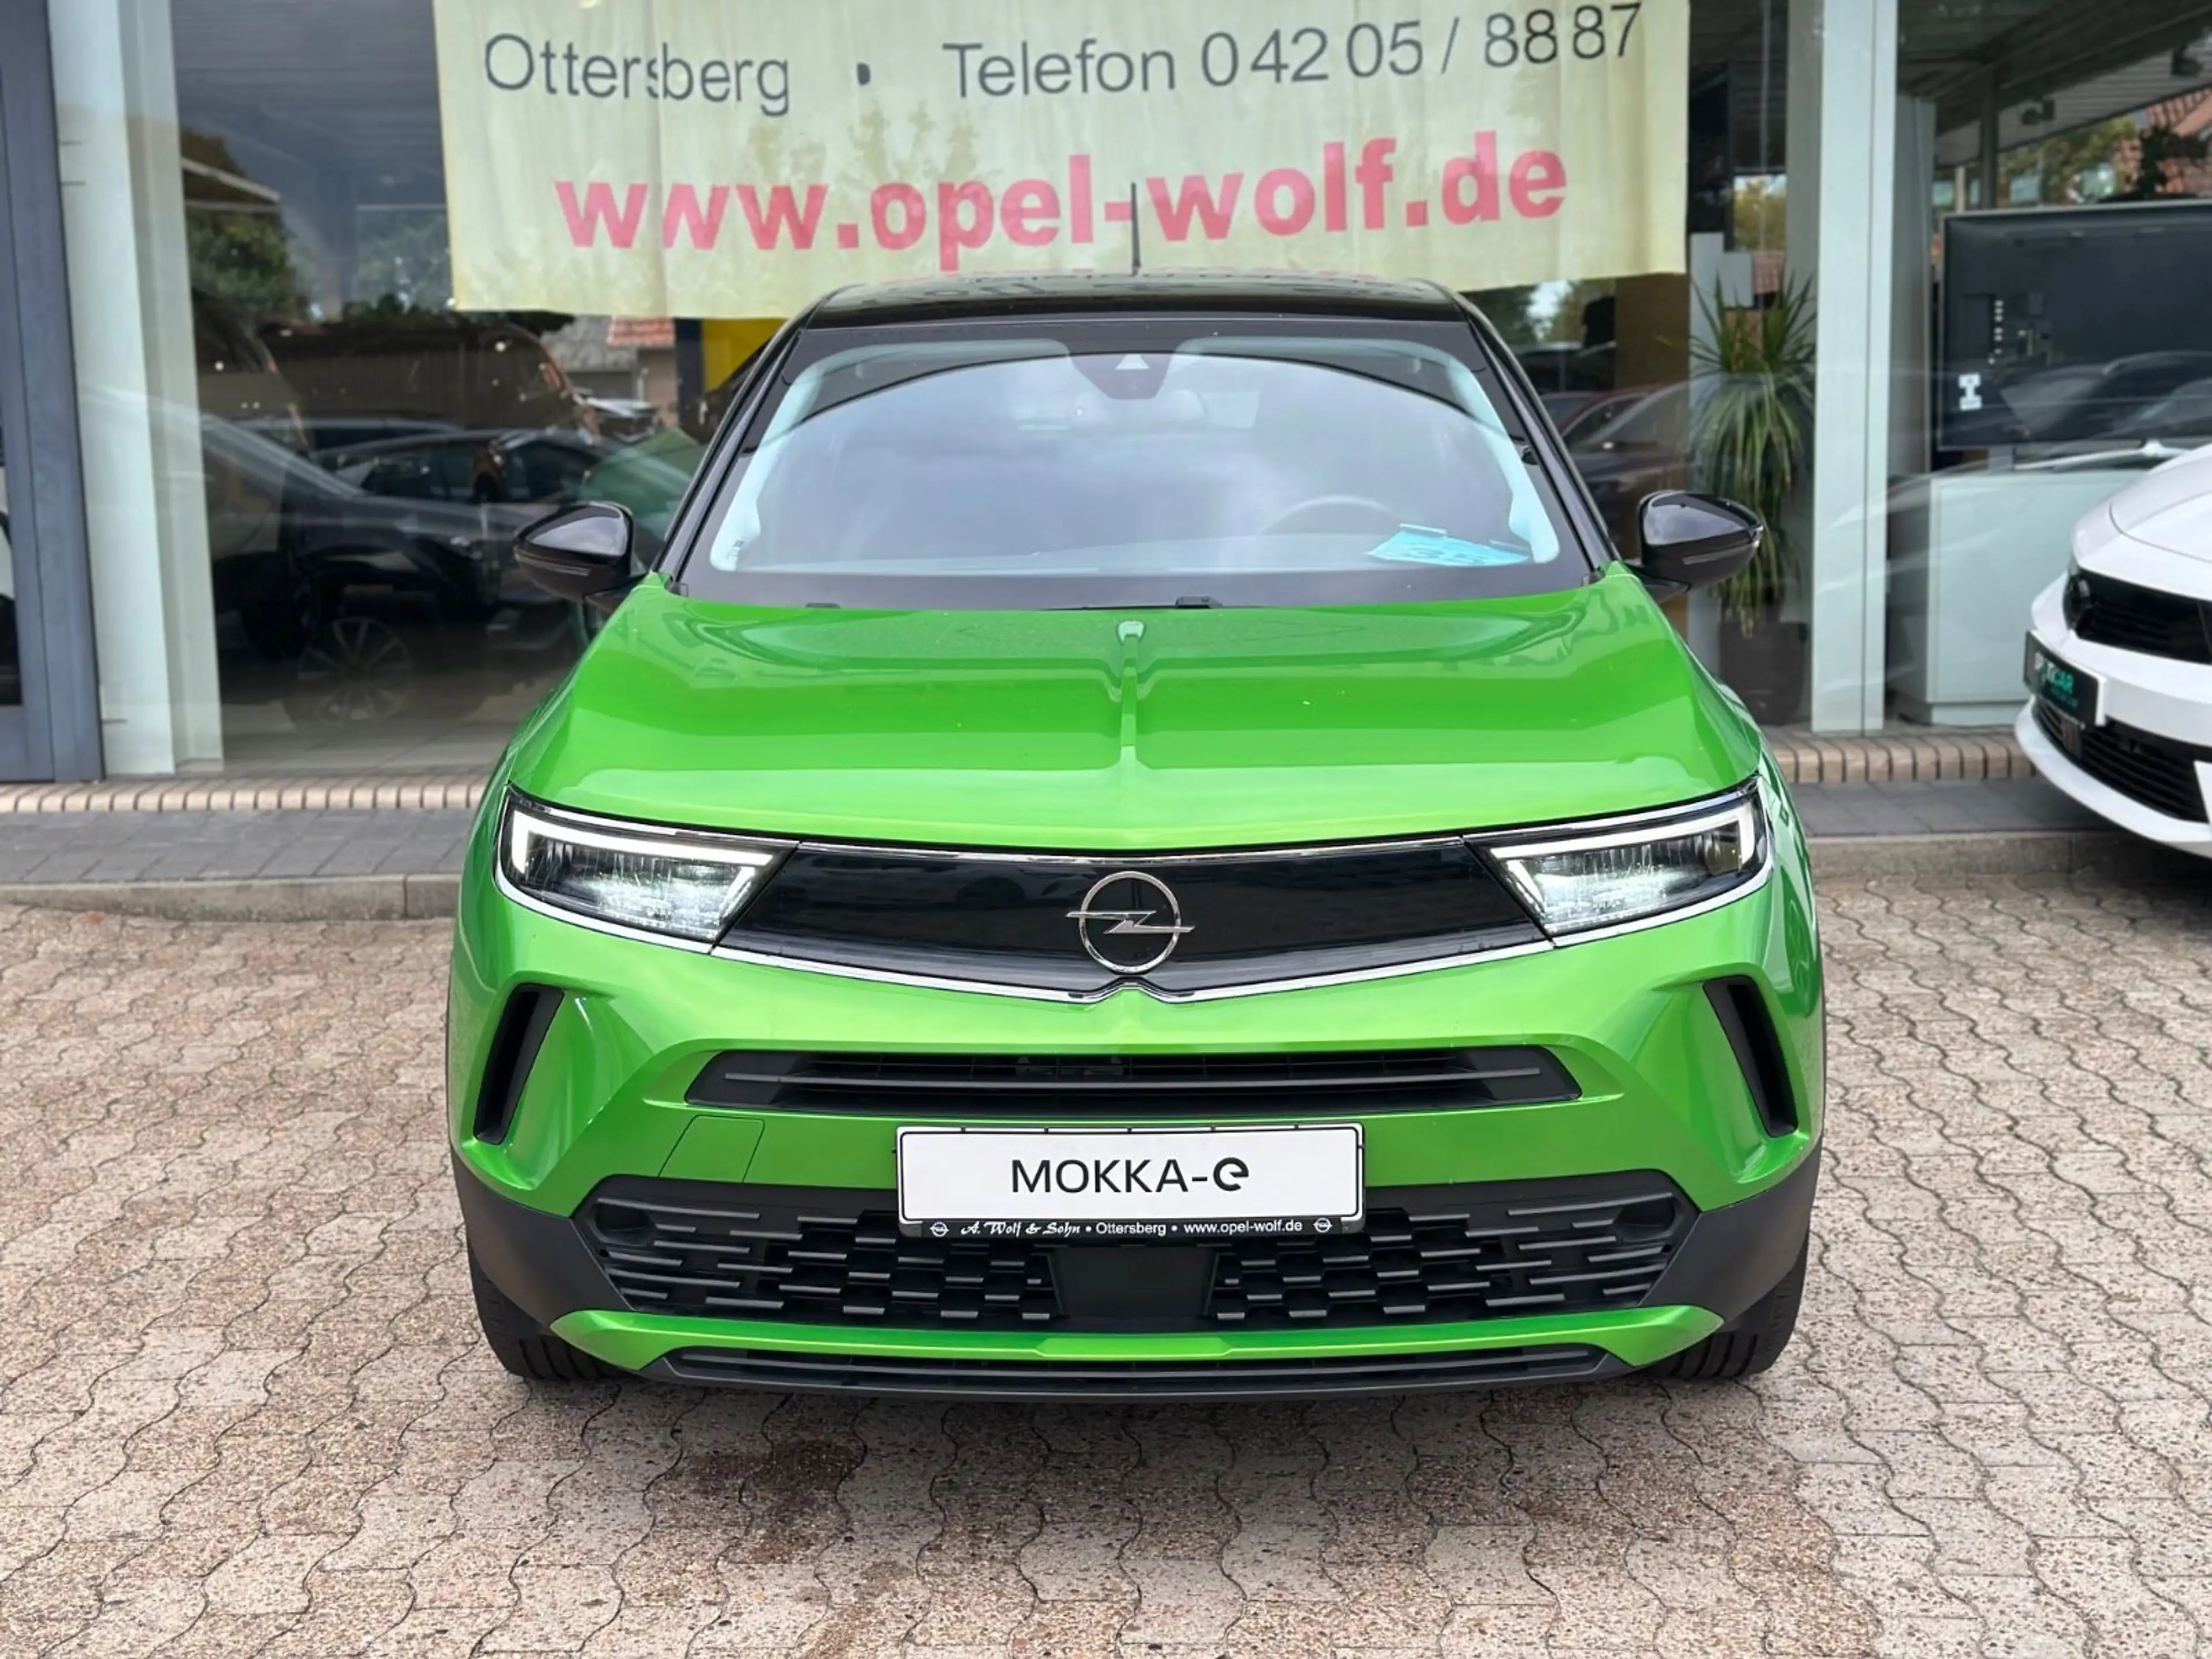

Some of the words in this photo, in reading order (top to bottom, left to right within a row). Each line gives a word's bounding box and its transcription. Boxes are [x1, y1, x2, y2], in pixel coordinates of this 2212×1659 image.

[942, 39, 1175, 98] Telefon
[556, 132, 1566, 275] www.opel-wolf.de
[1012, 1157, 1249, 1193] MOKKA-e
[984, 1221, 1021, 1237] Wolf
[1025, 1222, 1041, 1235] &
[1042, 1221, 1080, 1237] Sohn
[1096, 1222, 1166, 1237] Ottersberg
[1183, 1219, 1304, 1236] www.opel-wolf.de
